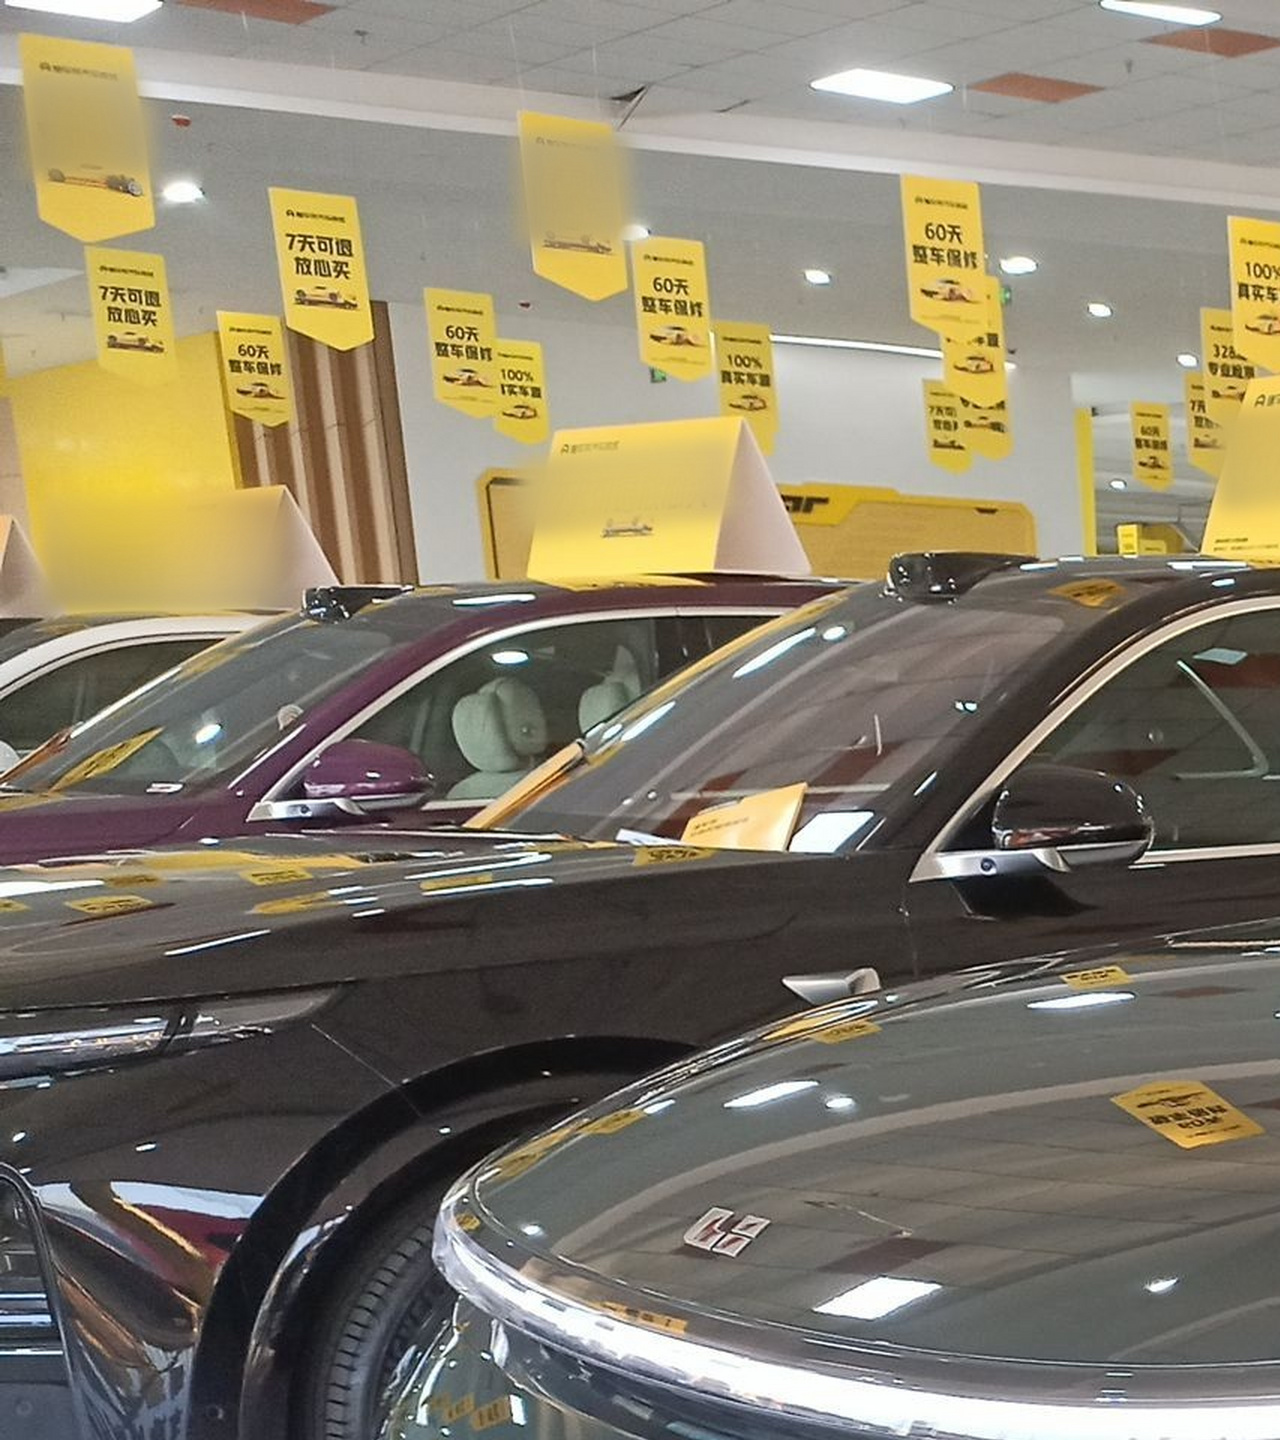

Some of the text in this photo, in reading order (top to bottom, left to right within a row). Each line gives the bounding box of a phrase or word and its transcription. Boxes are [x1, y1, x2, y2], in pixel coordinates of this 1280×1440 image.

[925, 222, 963, 244] 60天
[285, 233, 354, 257] 7天可退
[912, 244, 978, 269] 整车保修
[294, 257, 351, 280] 放心买
[98, 285, 162, 308] 7天可退
[653, 277, 690, 296] 60天
[107, 306, 158, 327] 放心买
[641, 295, 704, 318] 整车保修
[445, 325, 479, 342] 60天
[238, 344, 270, 359] 60天
[727, 354, 763, 369] 100%
[1213, 344, 1248, 361] 328
[501, 368, 534, 382] 100%
